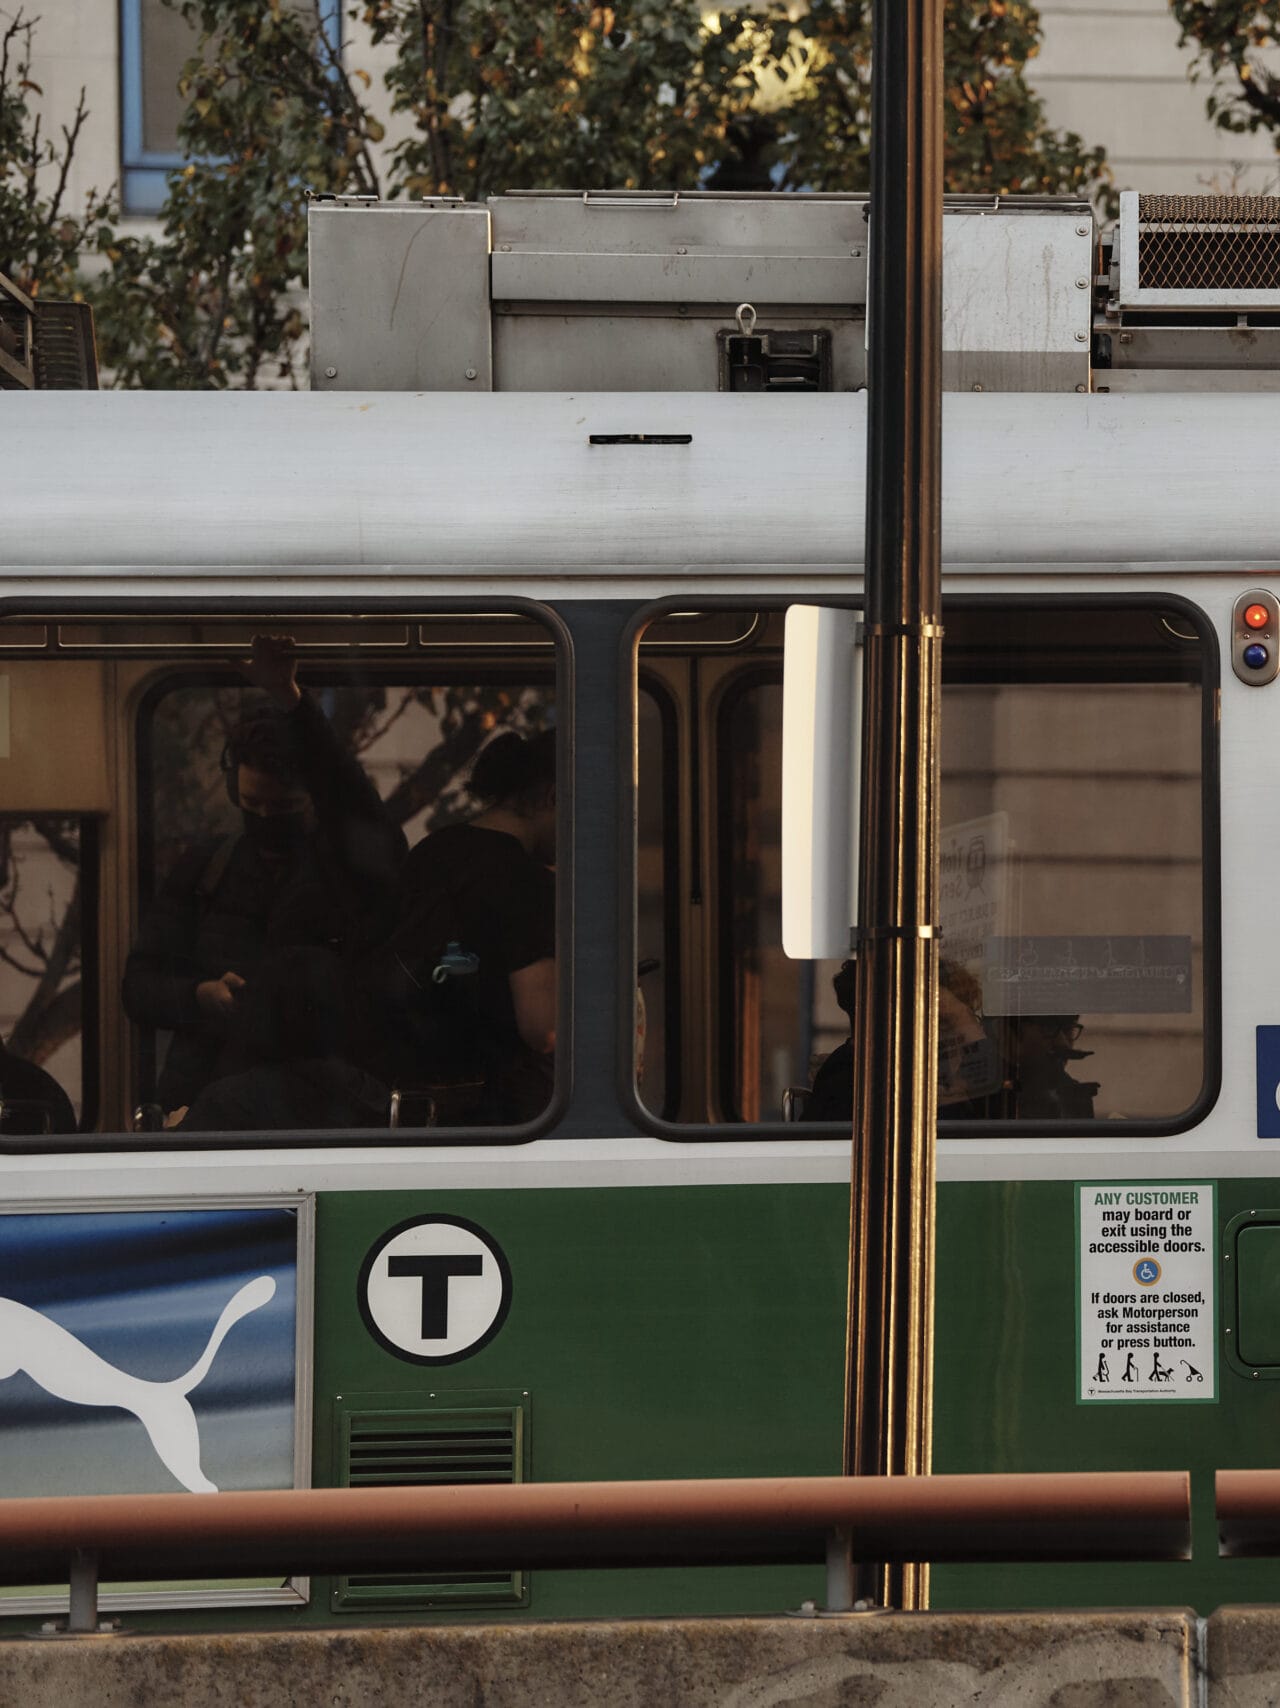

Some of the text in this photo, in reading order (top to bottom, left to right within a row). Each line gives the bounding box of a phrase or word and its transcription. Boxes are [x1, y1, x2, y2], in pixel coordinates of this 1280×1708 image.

[1094, 1192, 1199, 1205] ANY CUSTOMER
[1102, 1208, 1192, 1223] may board or
[1101, 1223, 1192, 1239] exit using the
[1089, 1240, 1205, 1253] accessible doors.
[387, 1254, 483, 1340] T
[1091, 1292, 1205, 1305] If doors are closed,
[1097, 1307, 1198, 1320] ask Motorperson
[1106, 1321, 1190, 1333] for assistance
[1101, 1336, 1196, 1350] or press button.
